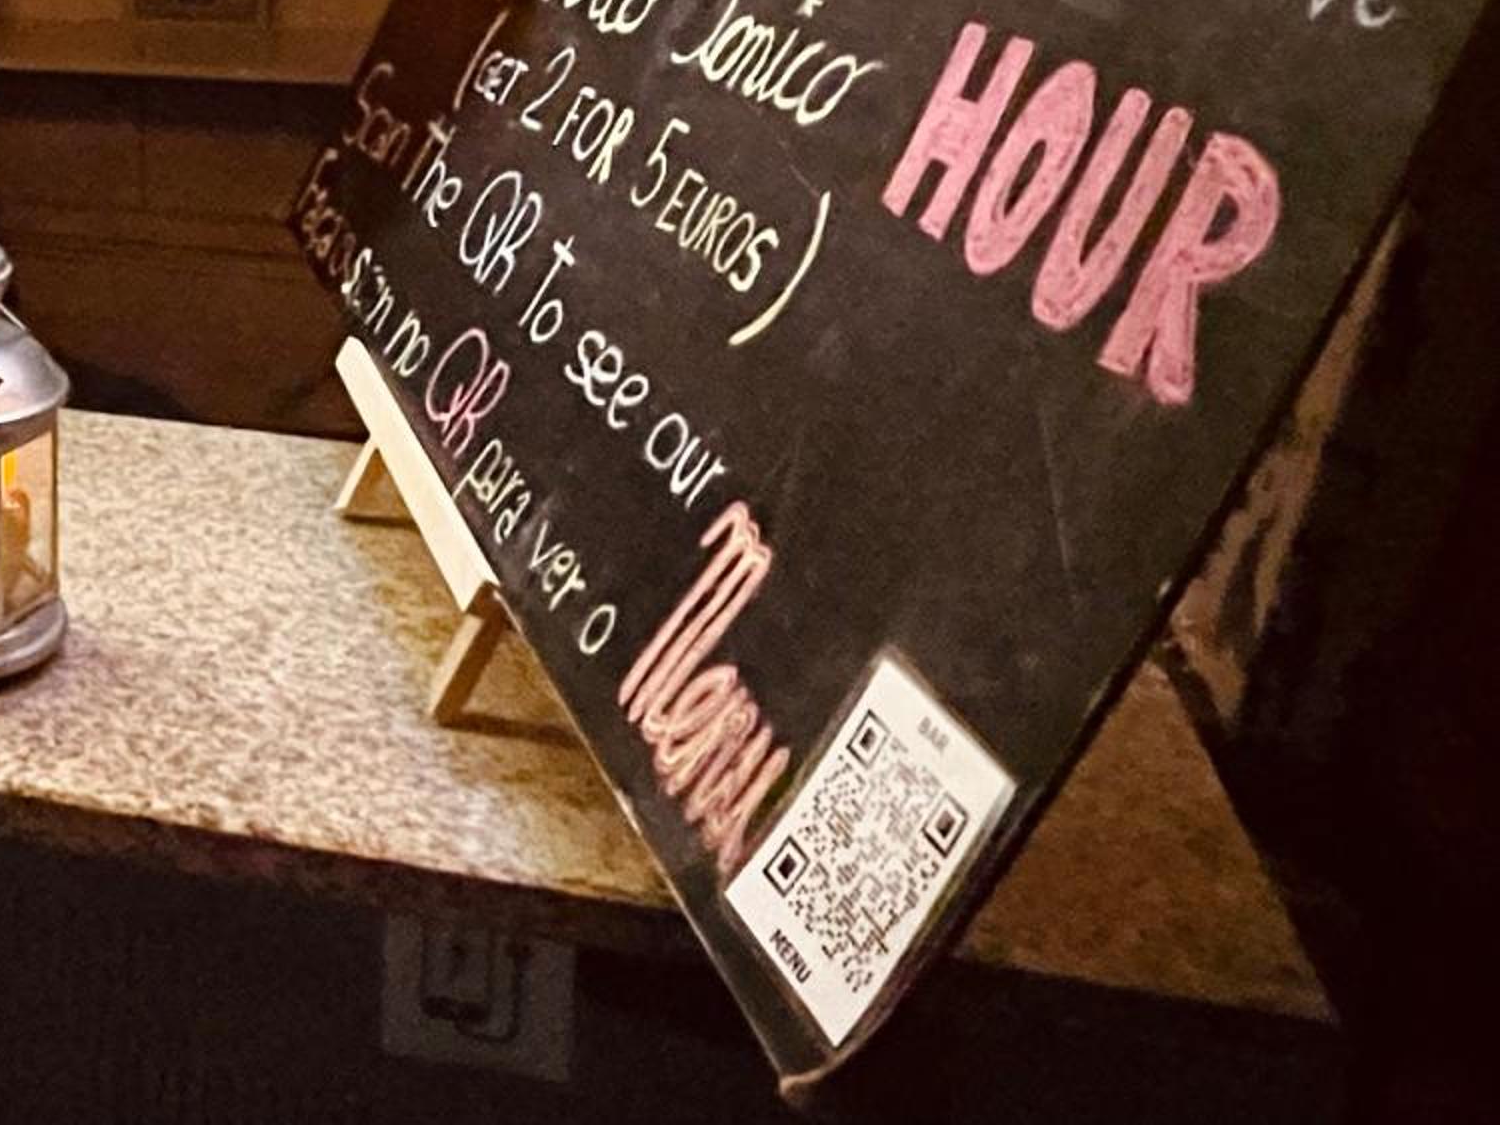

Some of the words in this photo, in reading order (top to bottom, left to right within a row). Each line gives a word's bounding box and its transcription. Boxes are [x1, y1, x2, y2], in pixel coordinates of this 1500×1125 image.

[520, 46, 576, 131] 2
[552, 86, 634, 185] FOR
[630, 118, 691, 208] 5
[880, 21, 1280, 407] HOUR
[383, 309, 431, 377] no
[425, 328, 511, 459] QR
[459, 170, 542, 296] QR
[564, 330, 650, 430] see
[644, 412, 728, 513] our
[452, 438, 533, 544] para
[529, 519, 587, 611] ver
[916, 716, 951, 753] BAR
[769, 927, 813, 985] MENU
